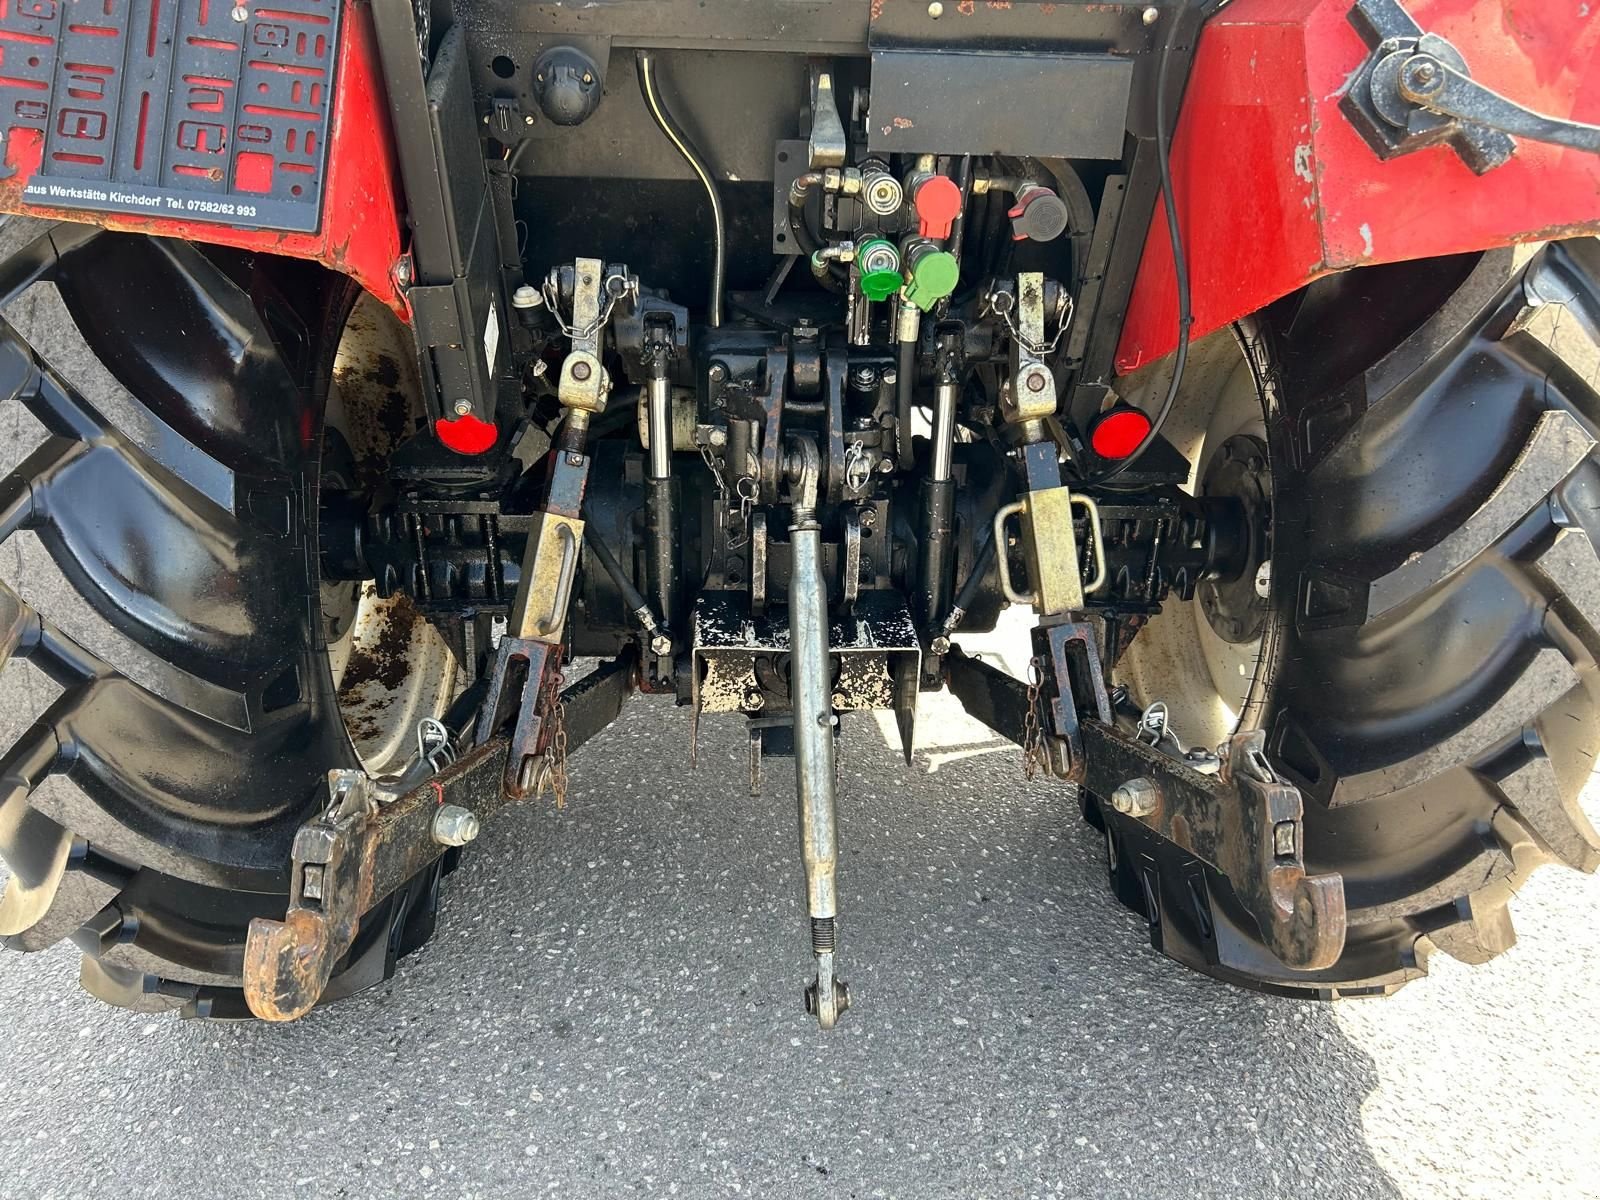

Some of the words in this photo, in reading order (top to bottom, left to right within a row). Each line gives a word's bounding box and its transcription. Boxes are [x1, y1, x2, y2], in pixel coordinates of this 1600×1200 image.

[50, 185, 107, 201] Werkstätte
[109, 191, 162, 207] Kirchdorf
[166, 197, 185, 210] Tel.
[187, 199, 235, 215] 07582/62
[236, 205, 257, 217] 993
